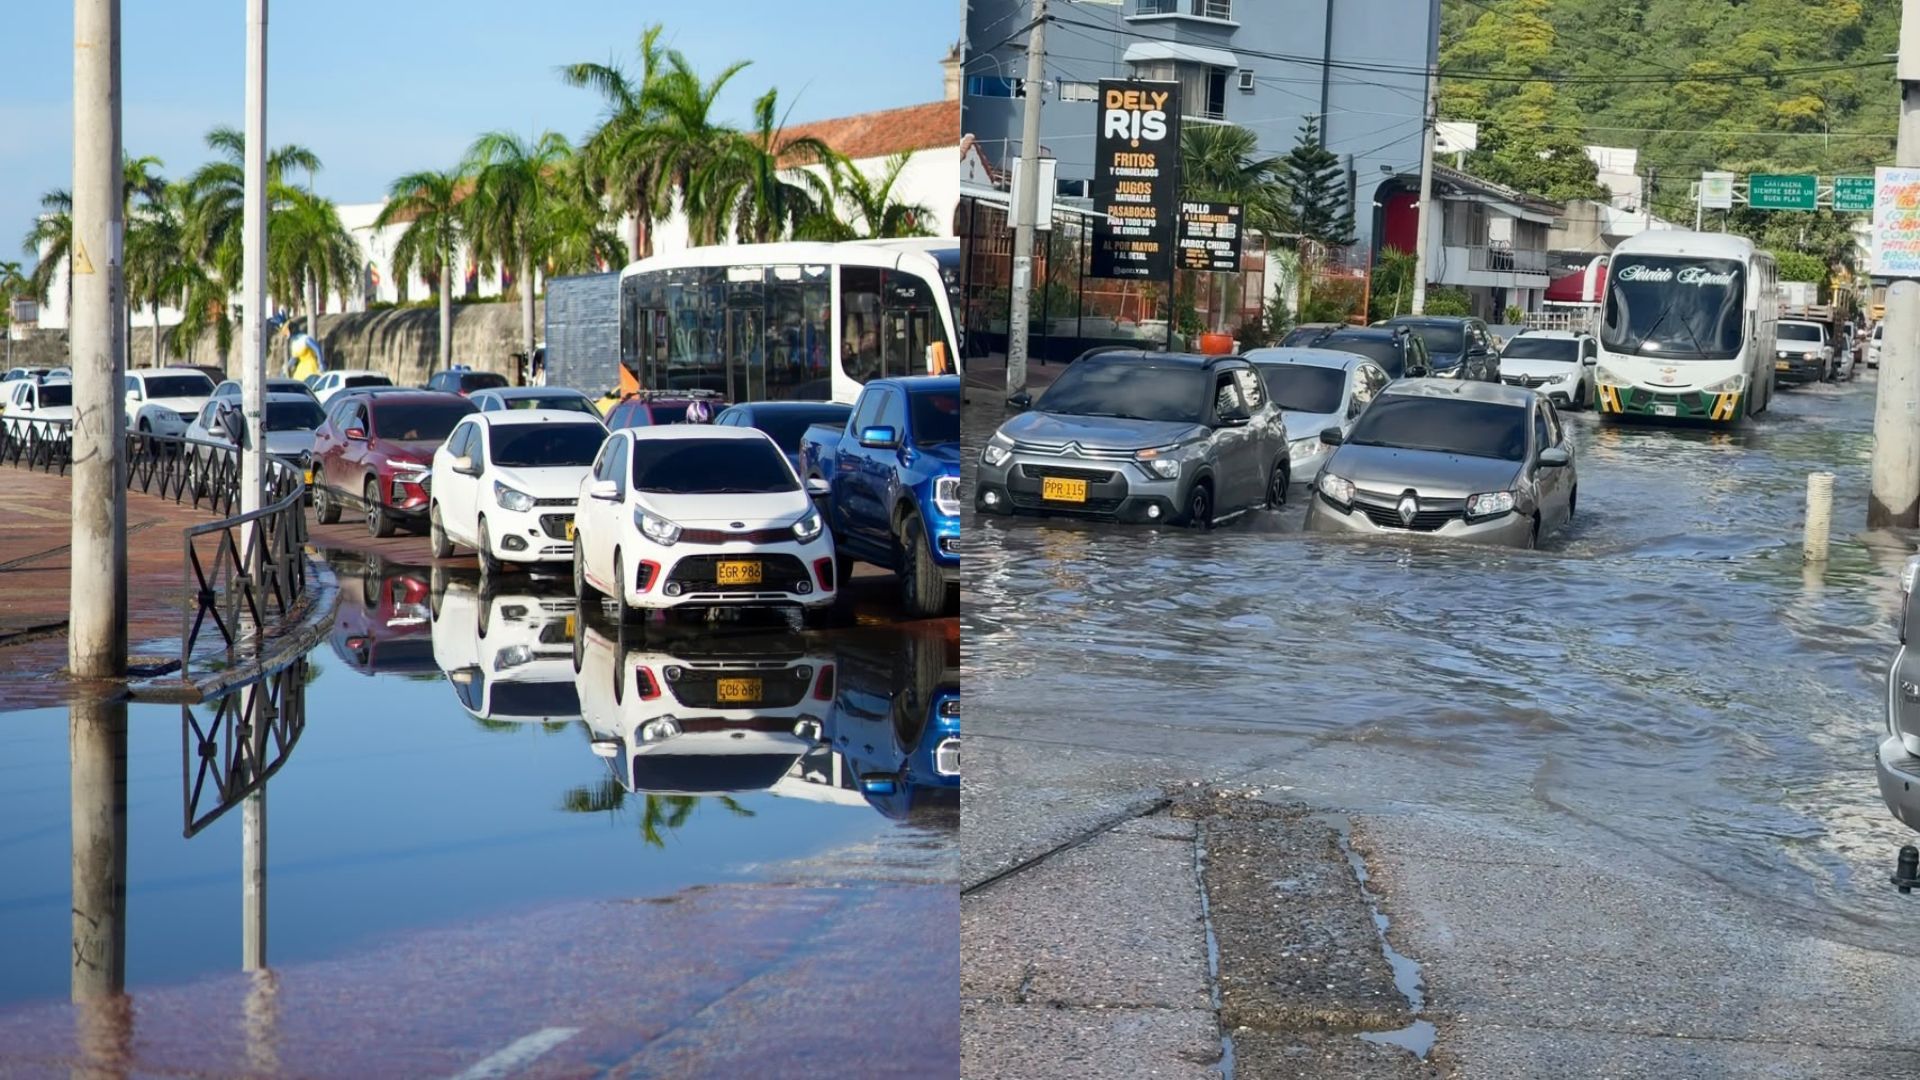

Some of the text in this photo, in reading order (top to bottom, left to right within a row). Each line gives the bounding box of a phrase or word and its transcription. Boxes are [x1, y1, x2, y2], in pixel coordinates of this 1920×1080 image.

[1106, 90, 1169, 111] DELY
[1114, 152, 1155, 168] FRITOS
[1109, 167, 1160, 177] Y CONGELADOS
[1115, 181, 1152, 194] JUGOS
[1764, 180, 1802, 188] CARTAGENA
[1115, 193, 1151, 203] NATURALES
[1842, 194, 1867, 202] HEREDIA
[1107, 205, 1156, 218] PASABOCAS
[1182, 203, 1210, 214] POLLO
[1125, 218, 1141, 226] TODO
[1142, 219, 1156, 227] TIPO
[1184, 213, 1189, 221] A
[1112, 226, 1150, 236] DE EVENTOS
[1103, 240, 1159, 253] AL POR MAYOR
[1180, 239, 1230, 251] ARROZ CHINO
[1113, 251, 1118, 259] Y
[1119, 251, 1127, 259] AL
[1618, 265, 1738, 288] Servicio Especial
[1045, 481, 1084, 496] PPR 115
[719, 565, 760, 578] EGR 986
